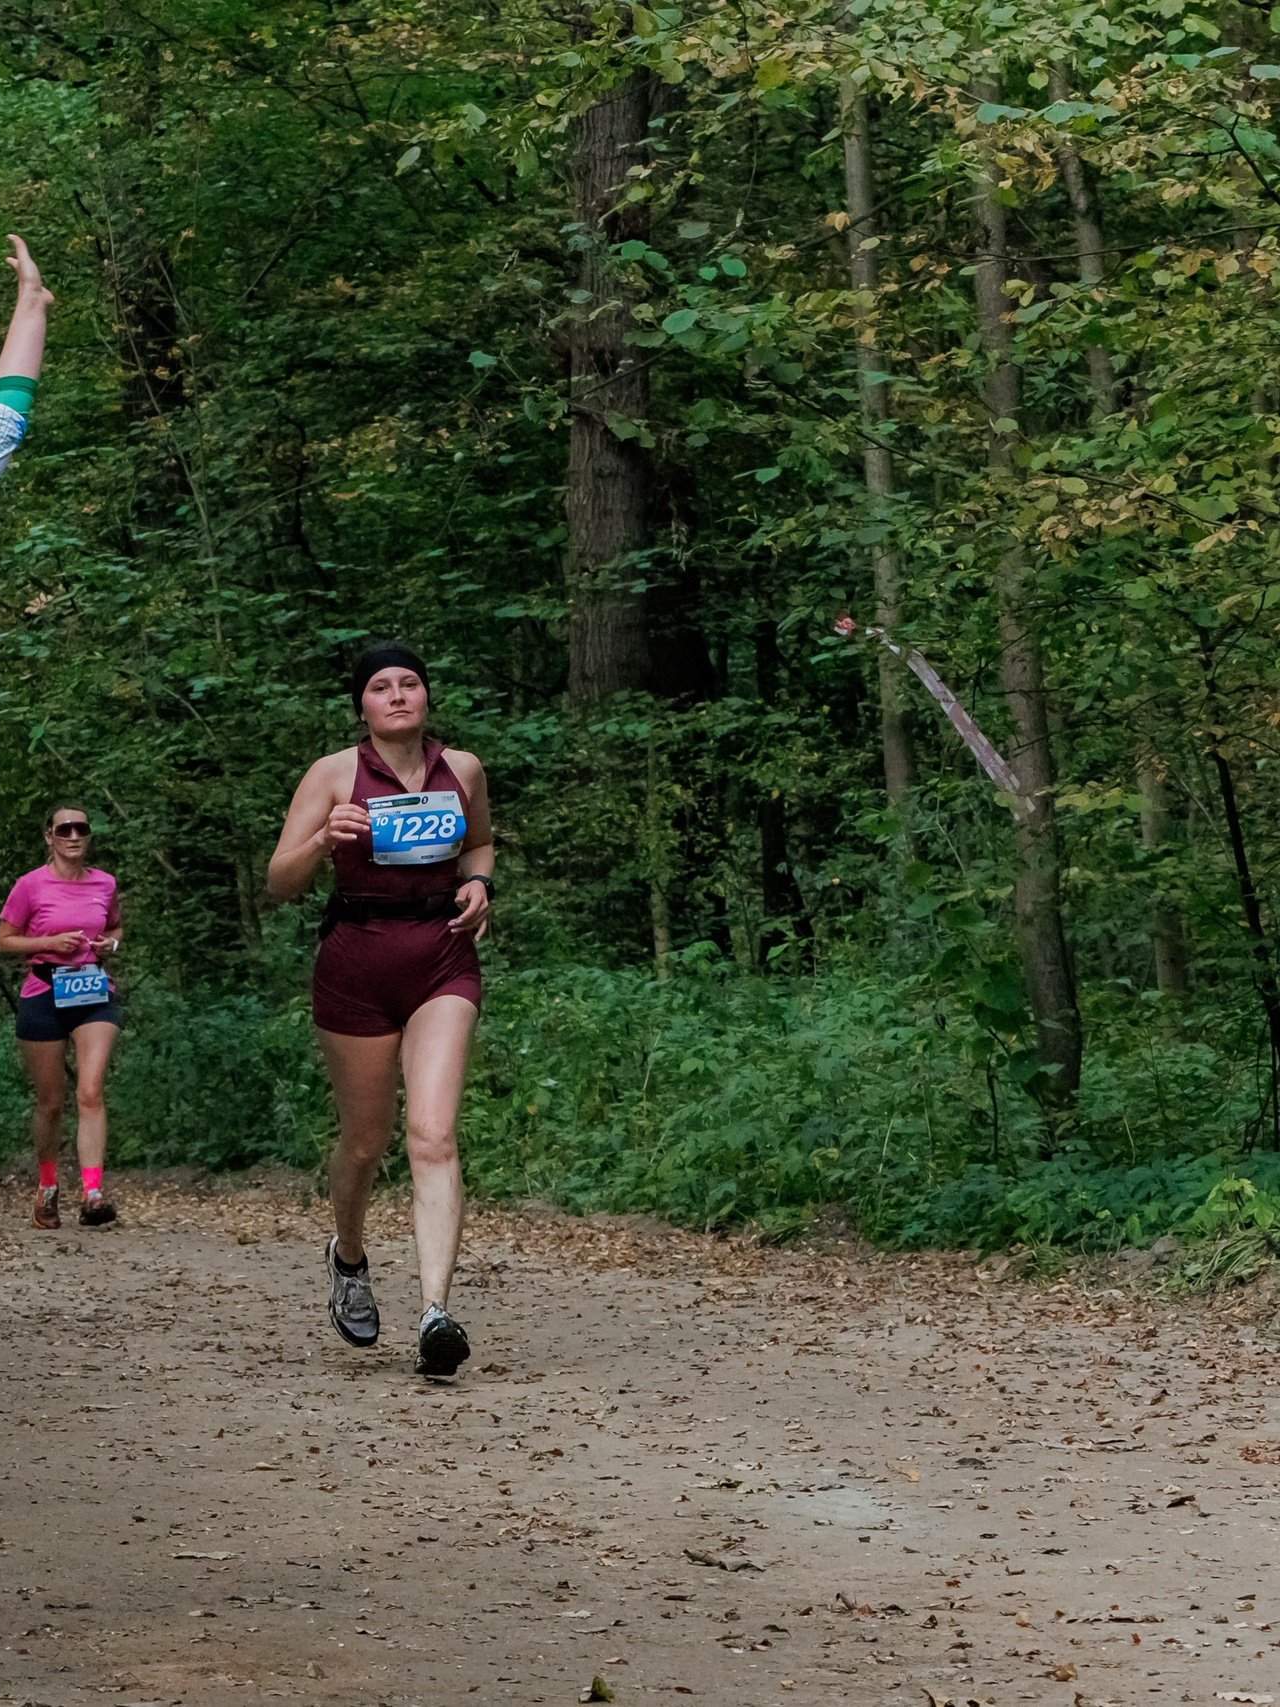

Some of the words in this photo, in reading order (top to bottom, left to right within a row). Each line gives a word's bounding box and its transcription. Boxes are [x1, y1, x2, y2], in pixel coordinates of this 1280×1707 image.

[376, 817, 389, 827] 10
[393, 813, 456, 842] 1228
[64, 976, 103, 994] 1035
